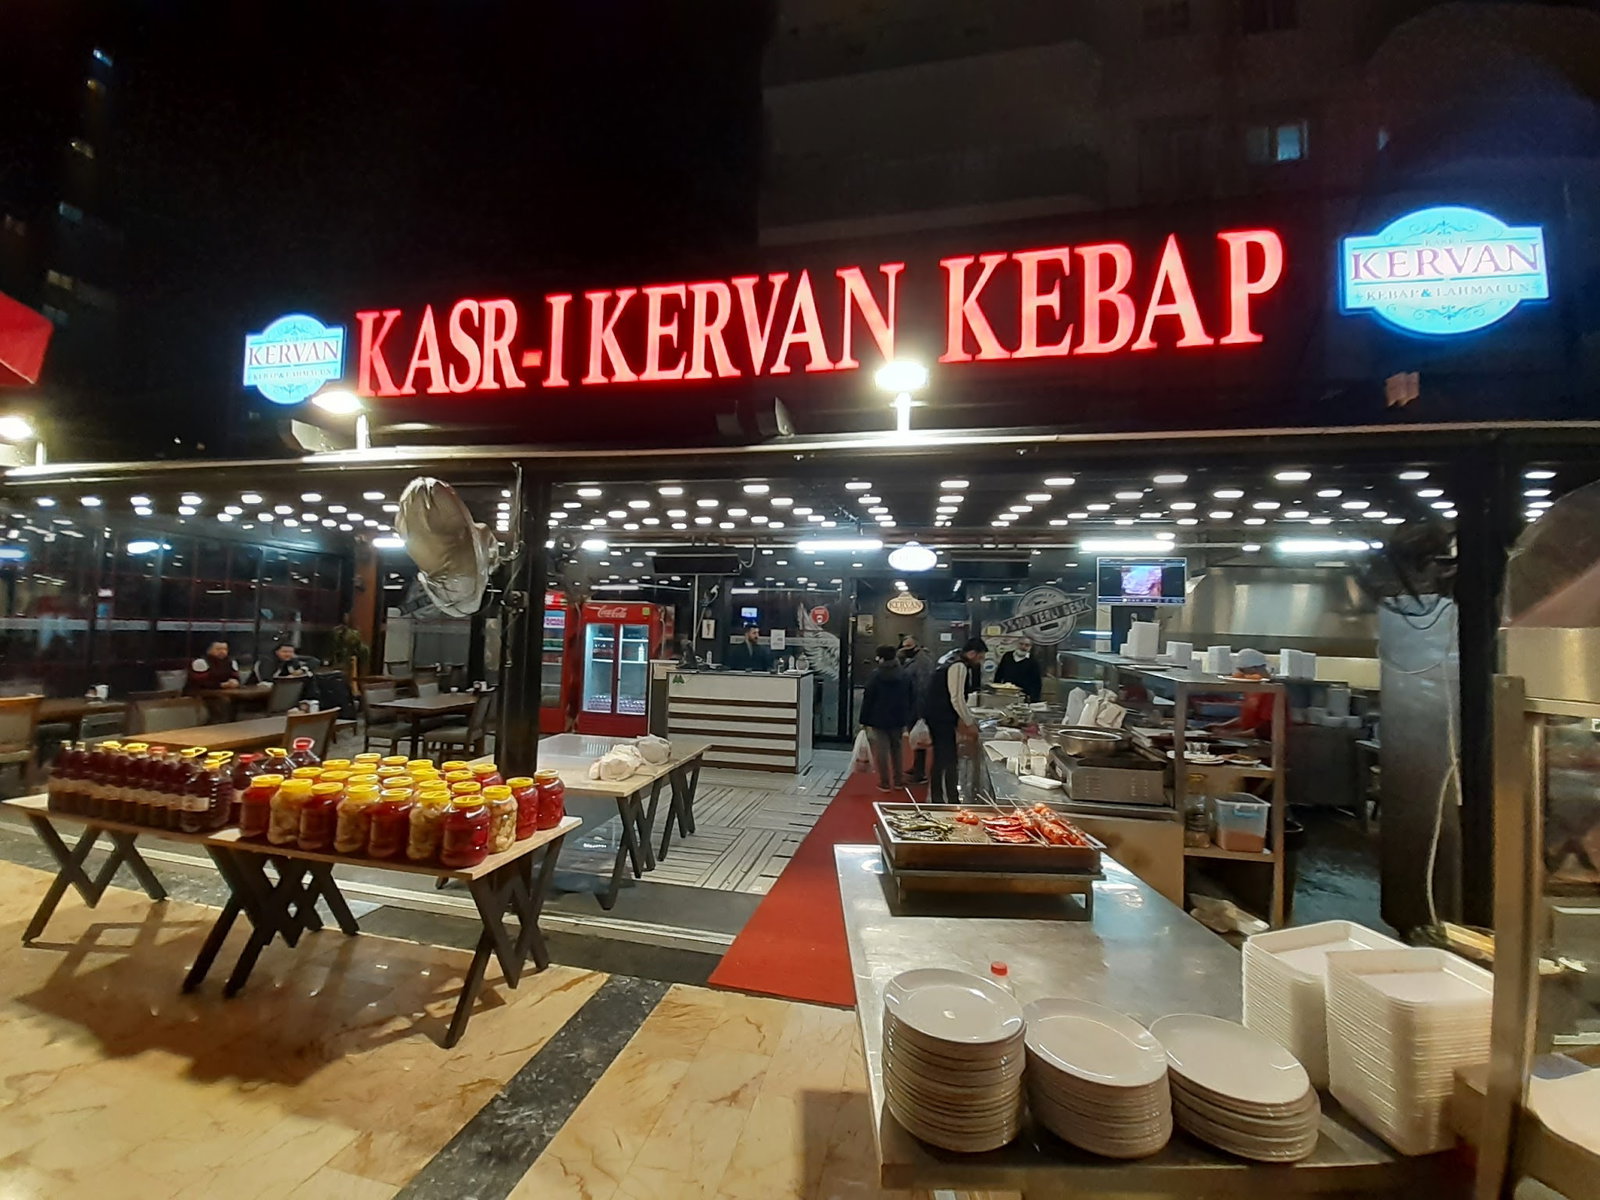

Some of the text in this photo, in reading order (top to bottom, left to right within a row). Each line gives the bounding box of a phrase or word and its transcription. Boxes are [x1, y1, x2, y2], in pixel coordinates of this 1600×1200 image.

[1351, 243, 1538, 280] KERVAN
[354, 227, 1285, 398] KASR-I KERVAN KEBAP
[249, 340, 339, 366] KERVAN
[889, 601, 922, 609] KERVAN
